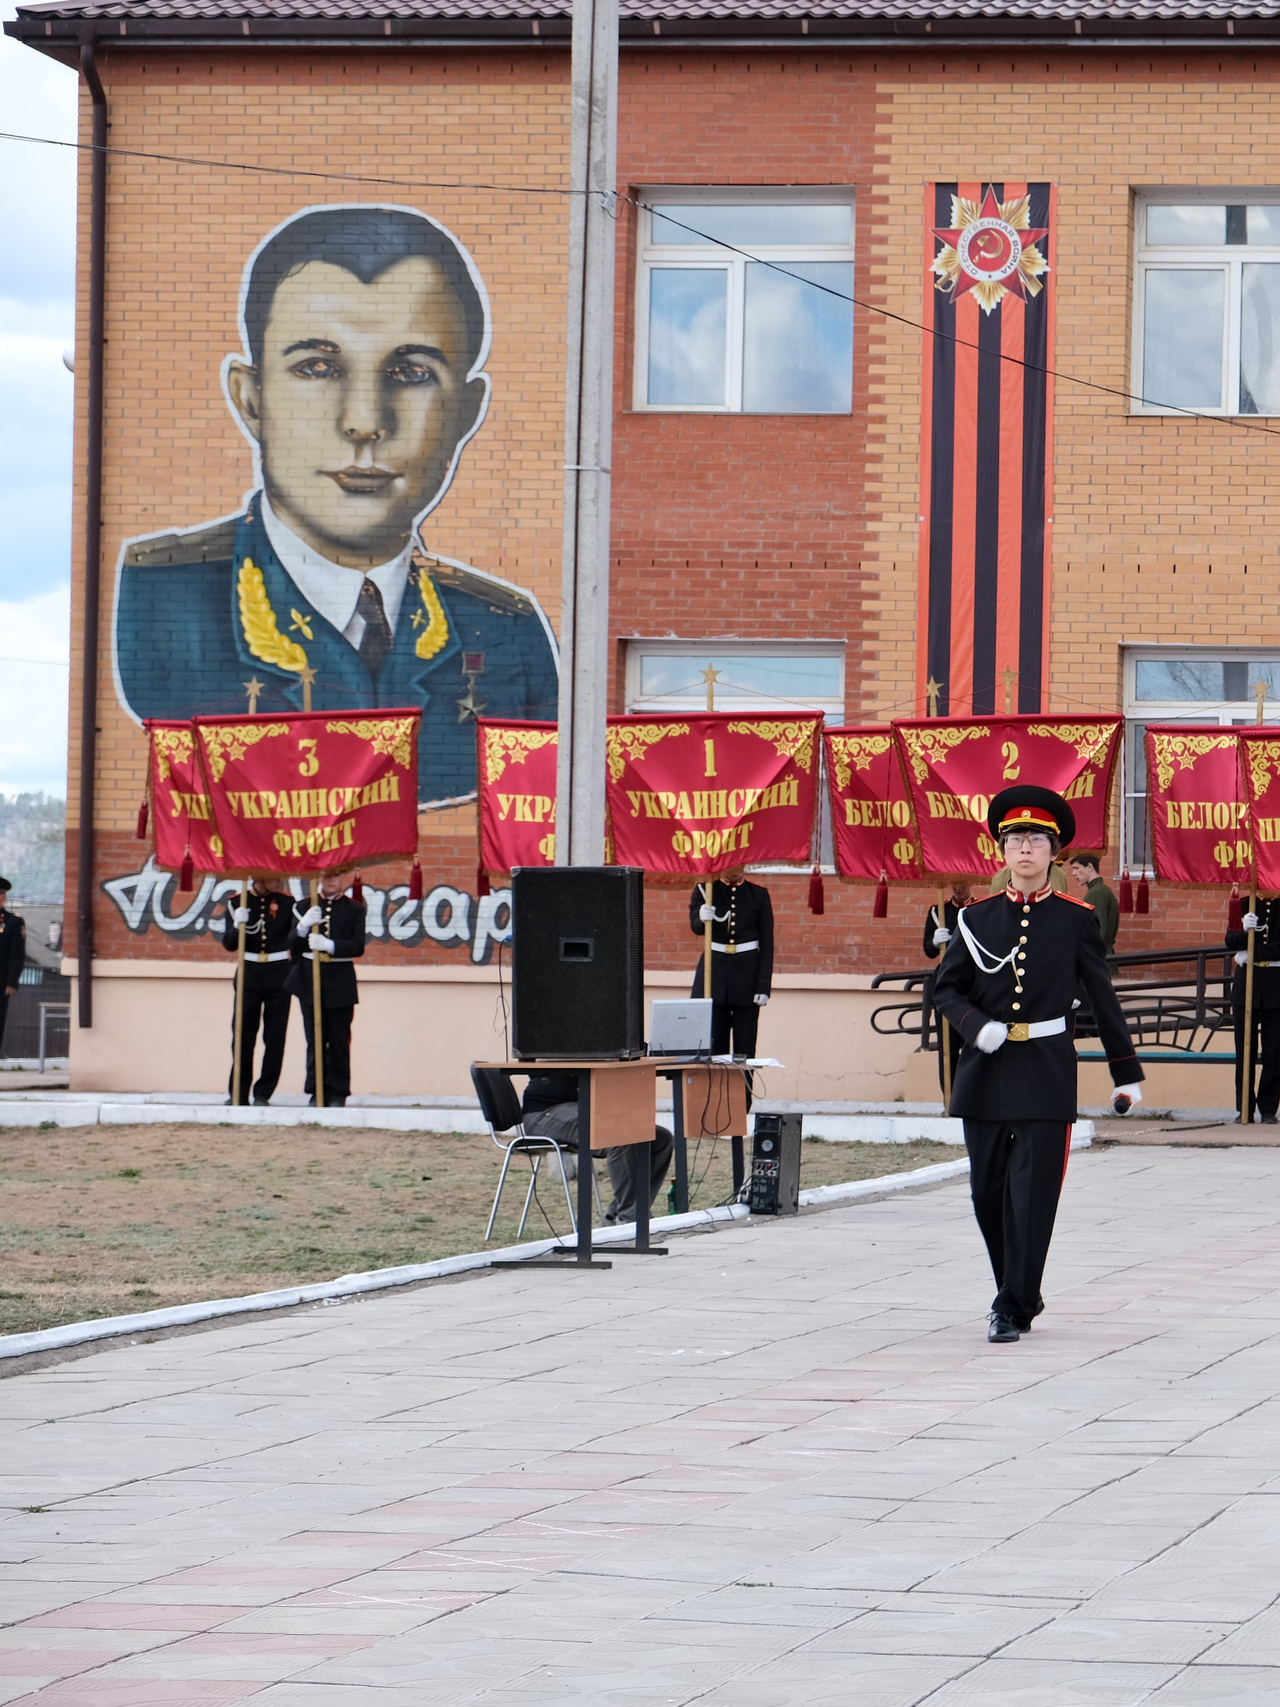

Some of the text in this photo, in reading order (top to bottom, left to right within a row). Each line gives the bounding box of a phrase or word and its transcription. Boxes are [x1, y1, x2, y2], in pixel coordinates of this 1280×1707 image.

[299, 738, 320, 777] 3
[704, 738, 718, 777] 1
[1001, 741, 1021, 780] 2
[226, 770, 400, 819] УКРАИНСКИЙ
[625, 774, 799, 819] УКРАИНСКИЙ
[272, 818, 356, 857] ФРОНТ
[671, 822, 754, 859] ФРОНТ
